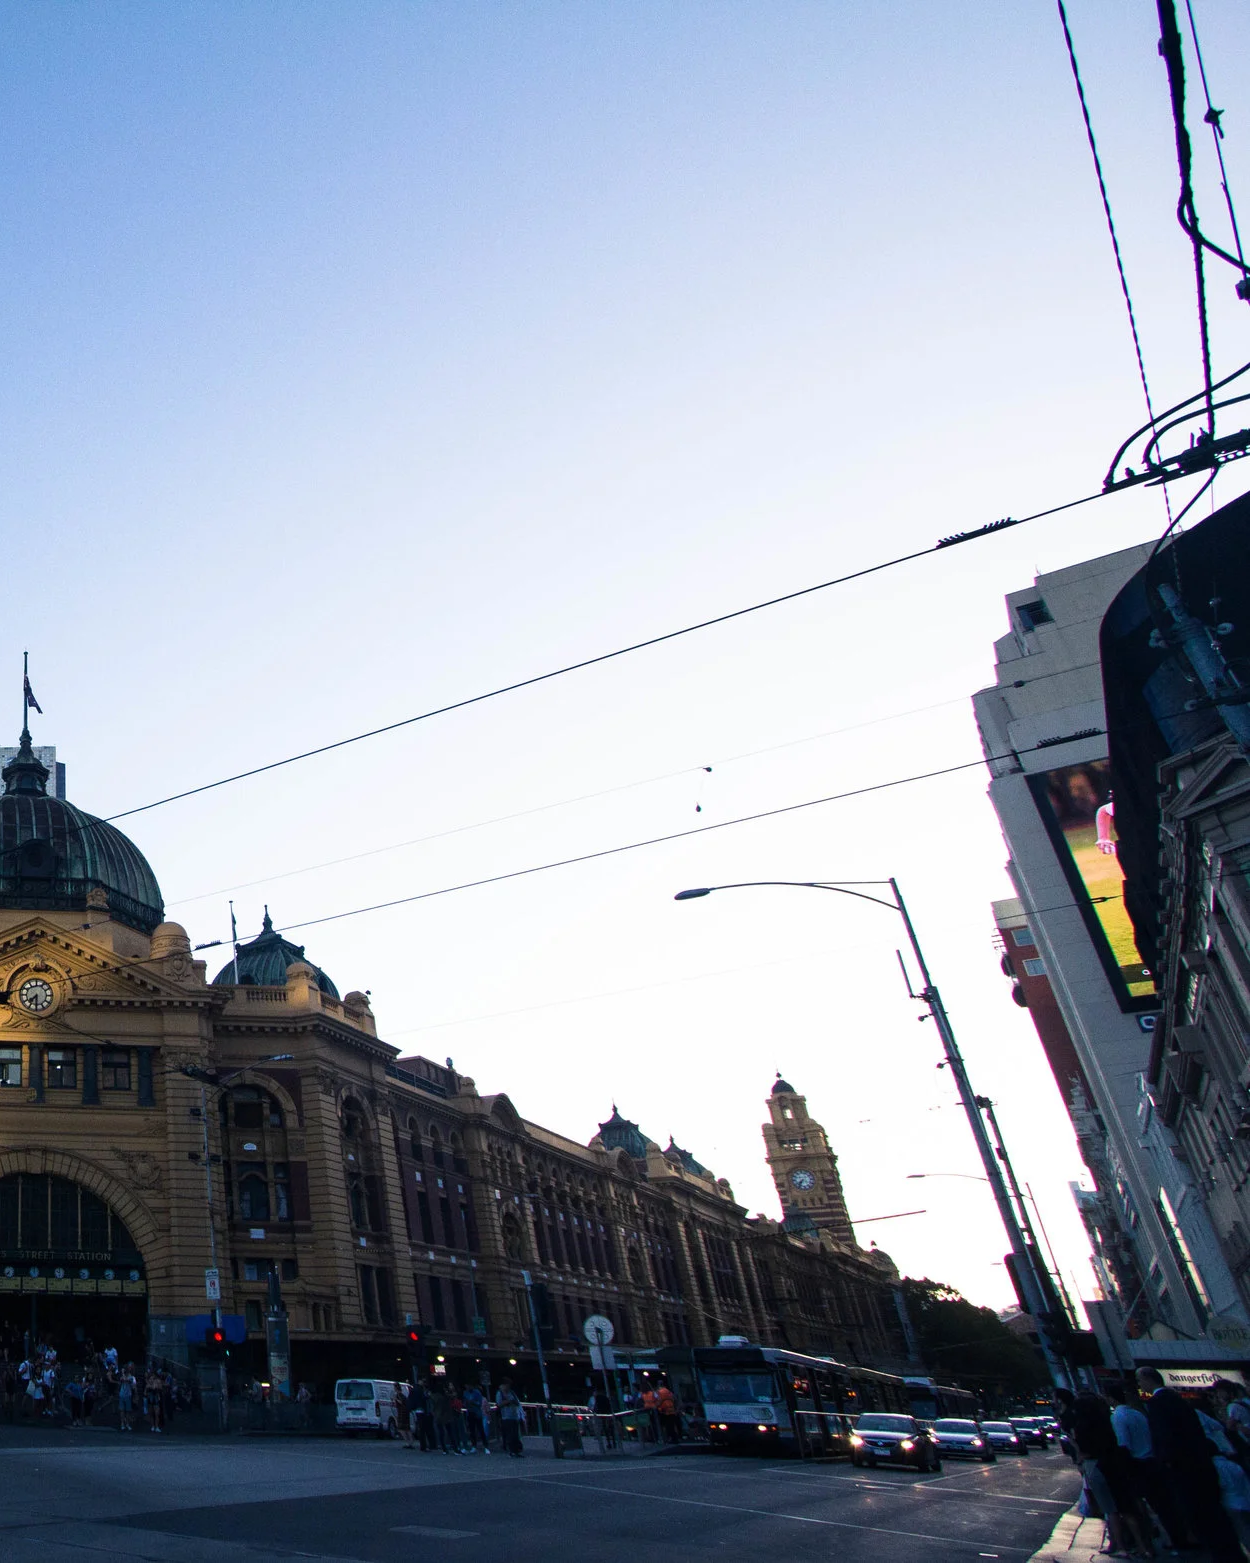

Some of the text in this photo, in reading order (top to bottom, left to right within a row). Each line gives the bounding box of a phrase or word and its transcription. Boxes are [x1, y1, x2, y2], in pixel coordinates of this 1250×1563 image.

[19, 1249, 55, 1260] STREET
[66, 1251, 112, 1262] STATION
[1168, 1373, 1223, 1384] dangerfield
